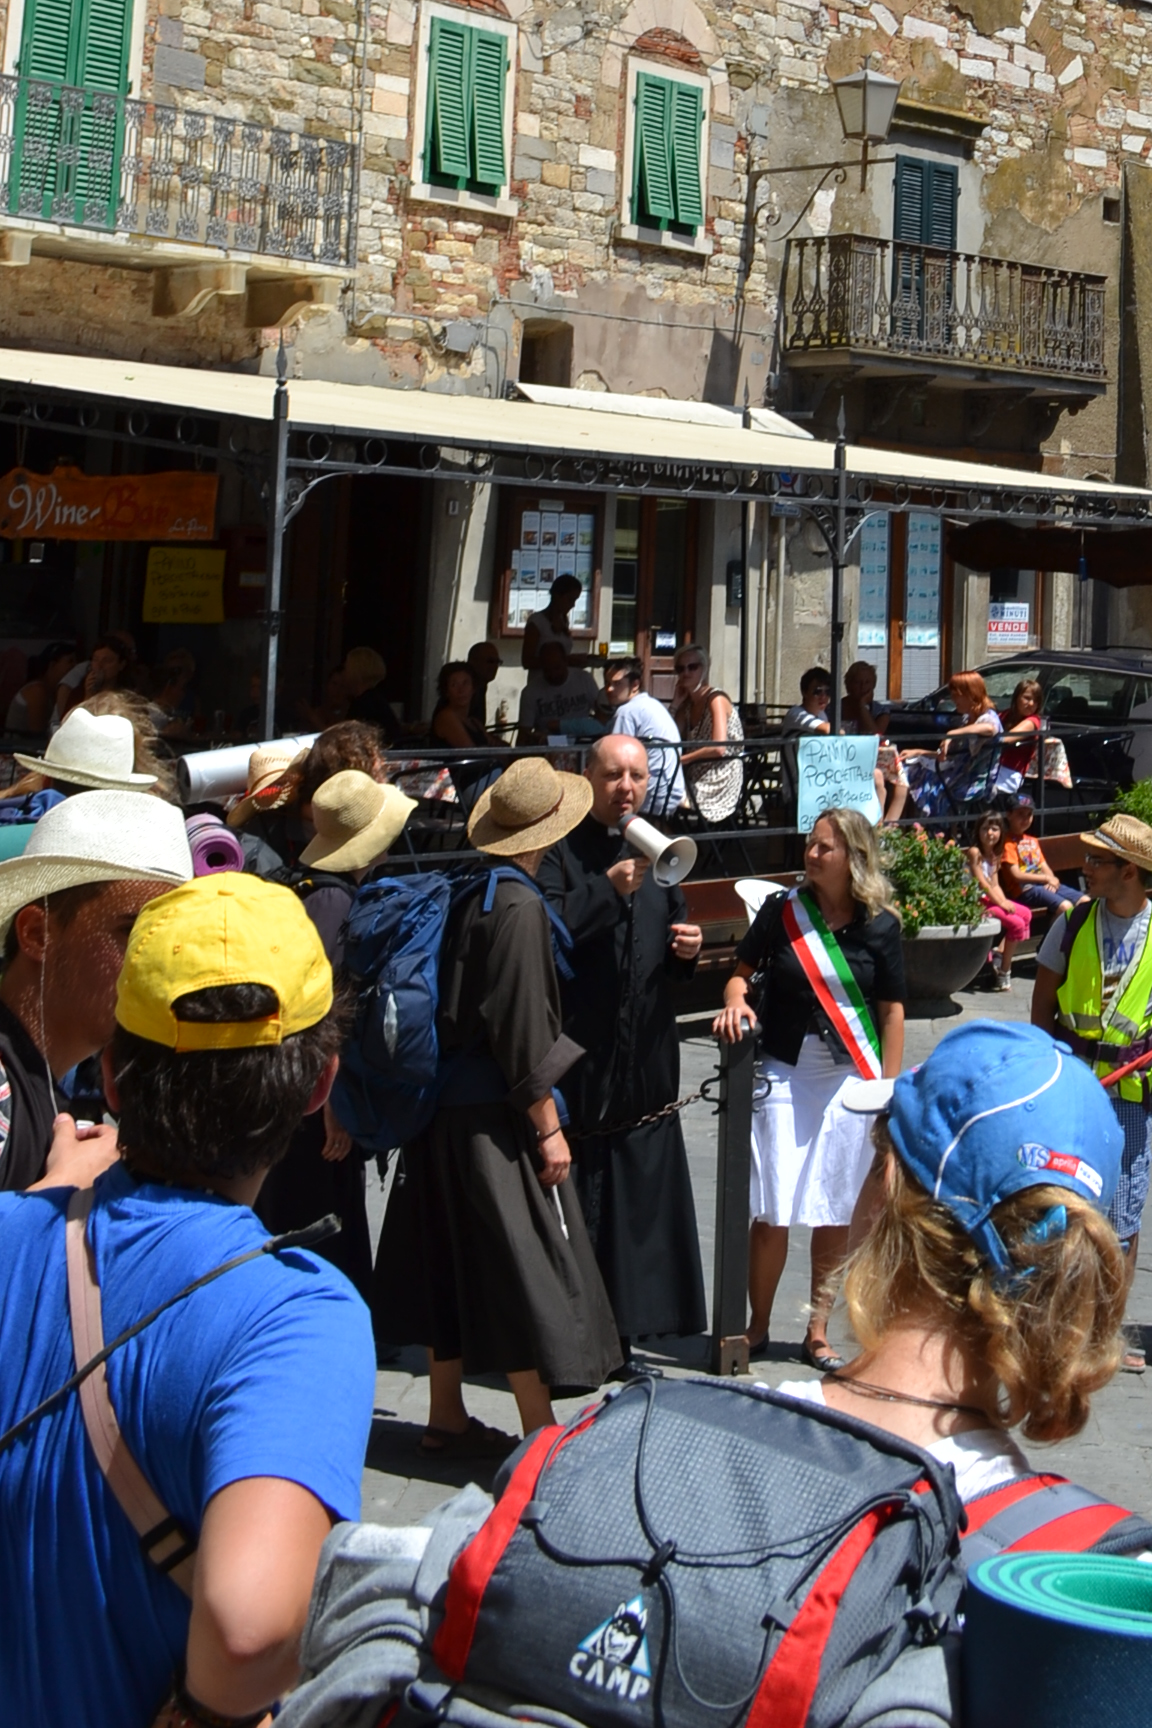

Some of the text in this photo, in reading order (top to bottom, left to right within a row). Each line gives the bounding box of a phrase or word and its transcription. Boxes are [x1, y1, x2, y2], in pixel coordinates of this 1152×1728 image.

[990, 622, 1027, 632] VENDE
[1020, 1144, 1077, 1170] MS aprilia
[568, 1650, 652, 1703] CAMP
